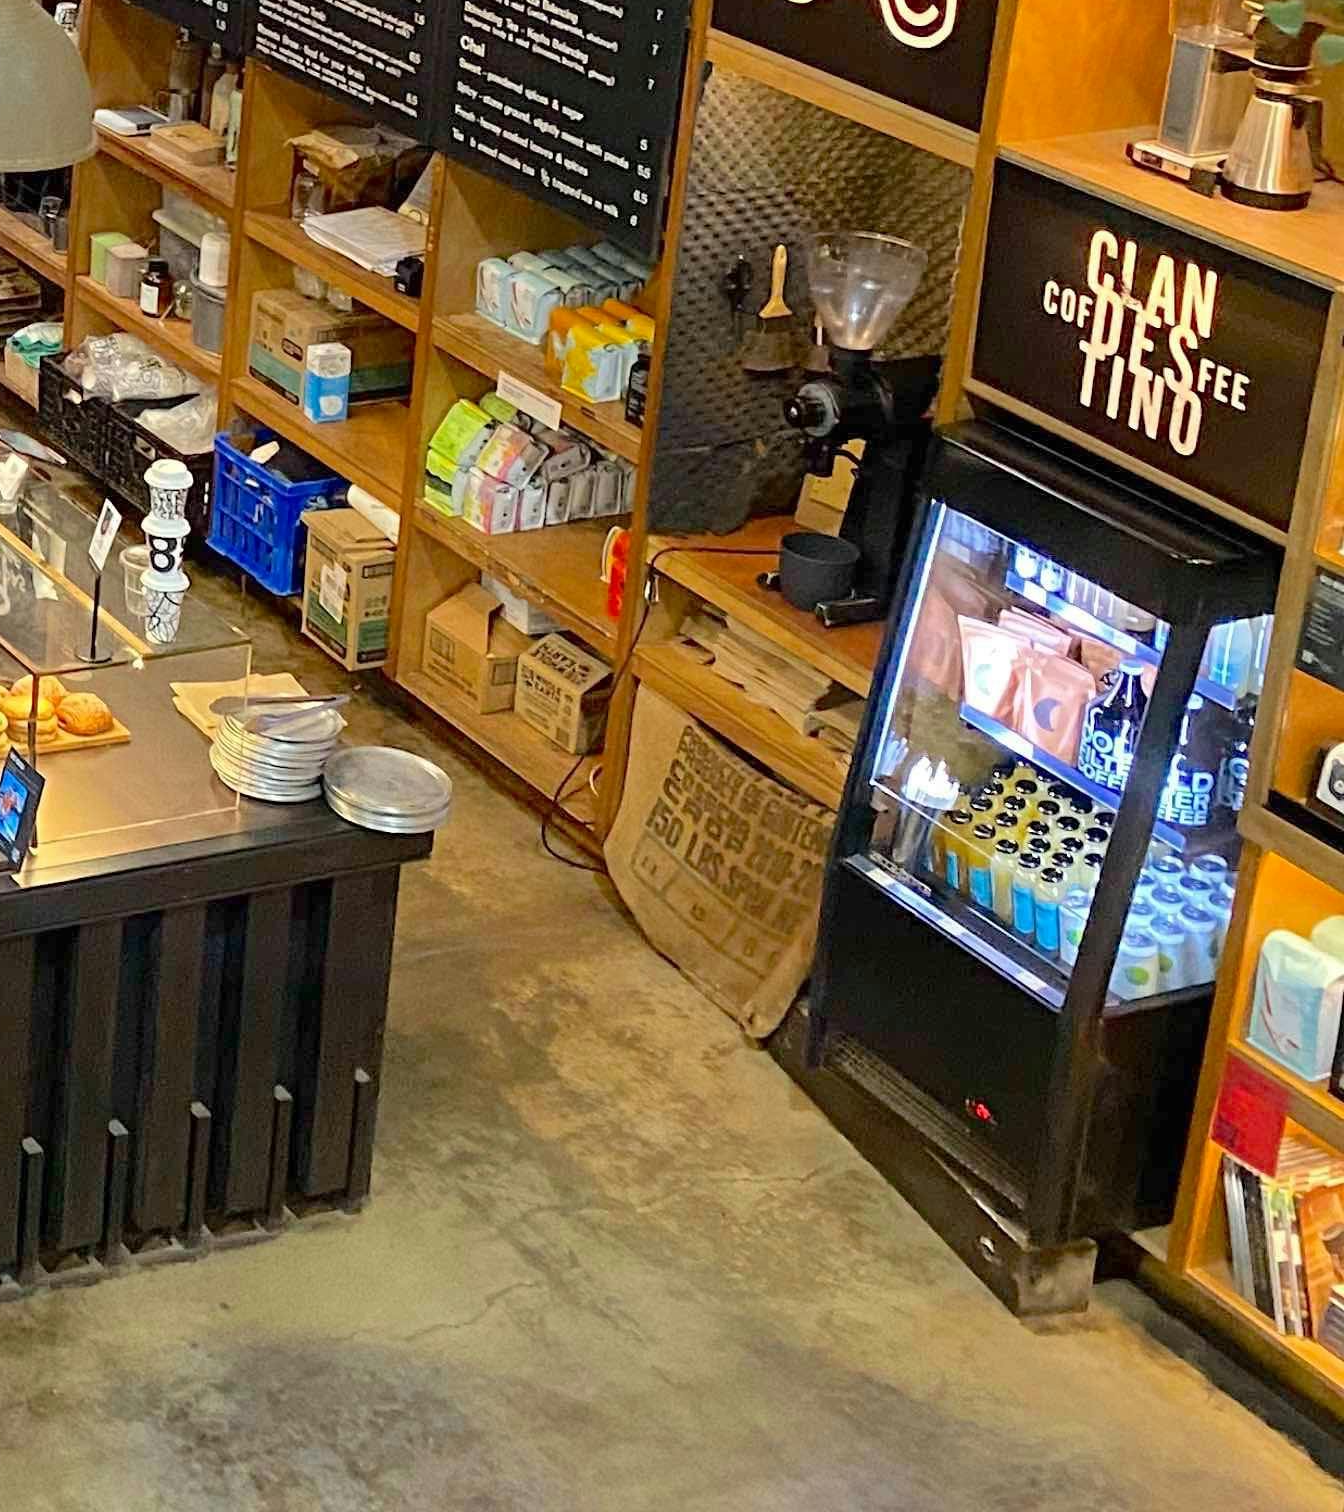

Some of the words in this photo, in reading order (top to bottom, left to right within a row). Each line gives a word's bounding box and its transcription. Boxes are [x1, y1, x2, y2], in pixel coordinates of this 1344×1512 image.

[460, 35, 485, 57] Chai
[1087, 230, 1218, 339] CLAN
[1043, 280, 1093, 328] COF
[1090, 273, 1199, 396] DES
[1197, 357, 1251, 412] FEE
[1079, 339, 1203, 457] TINO
